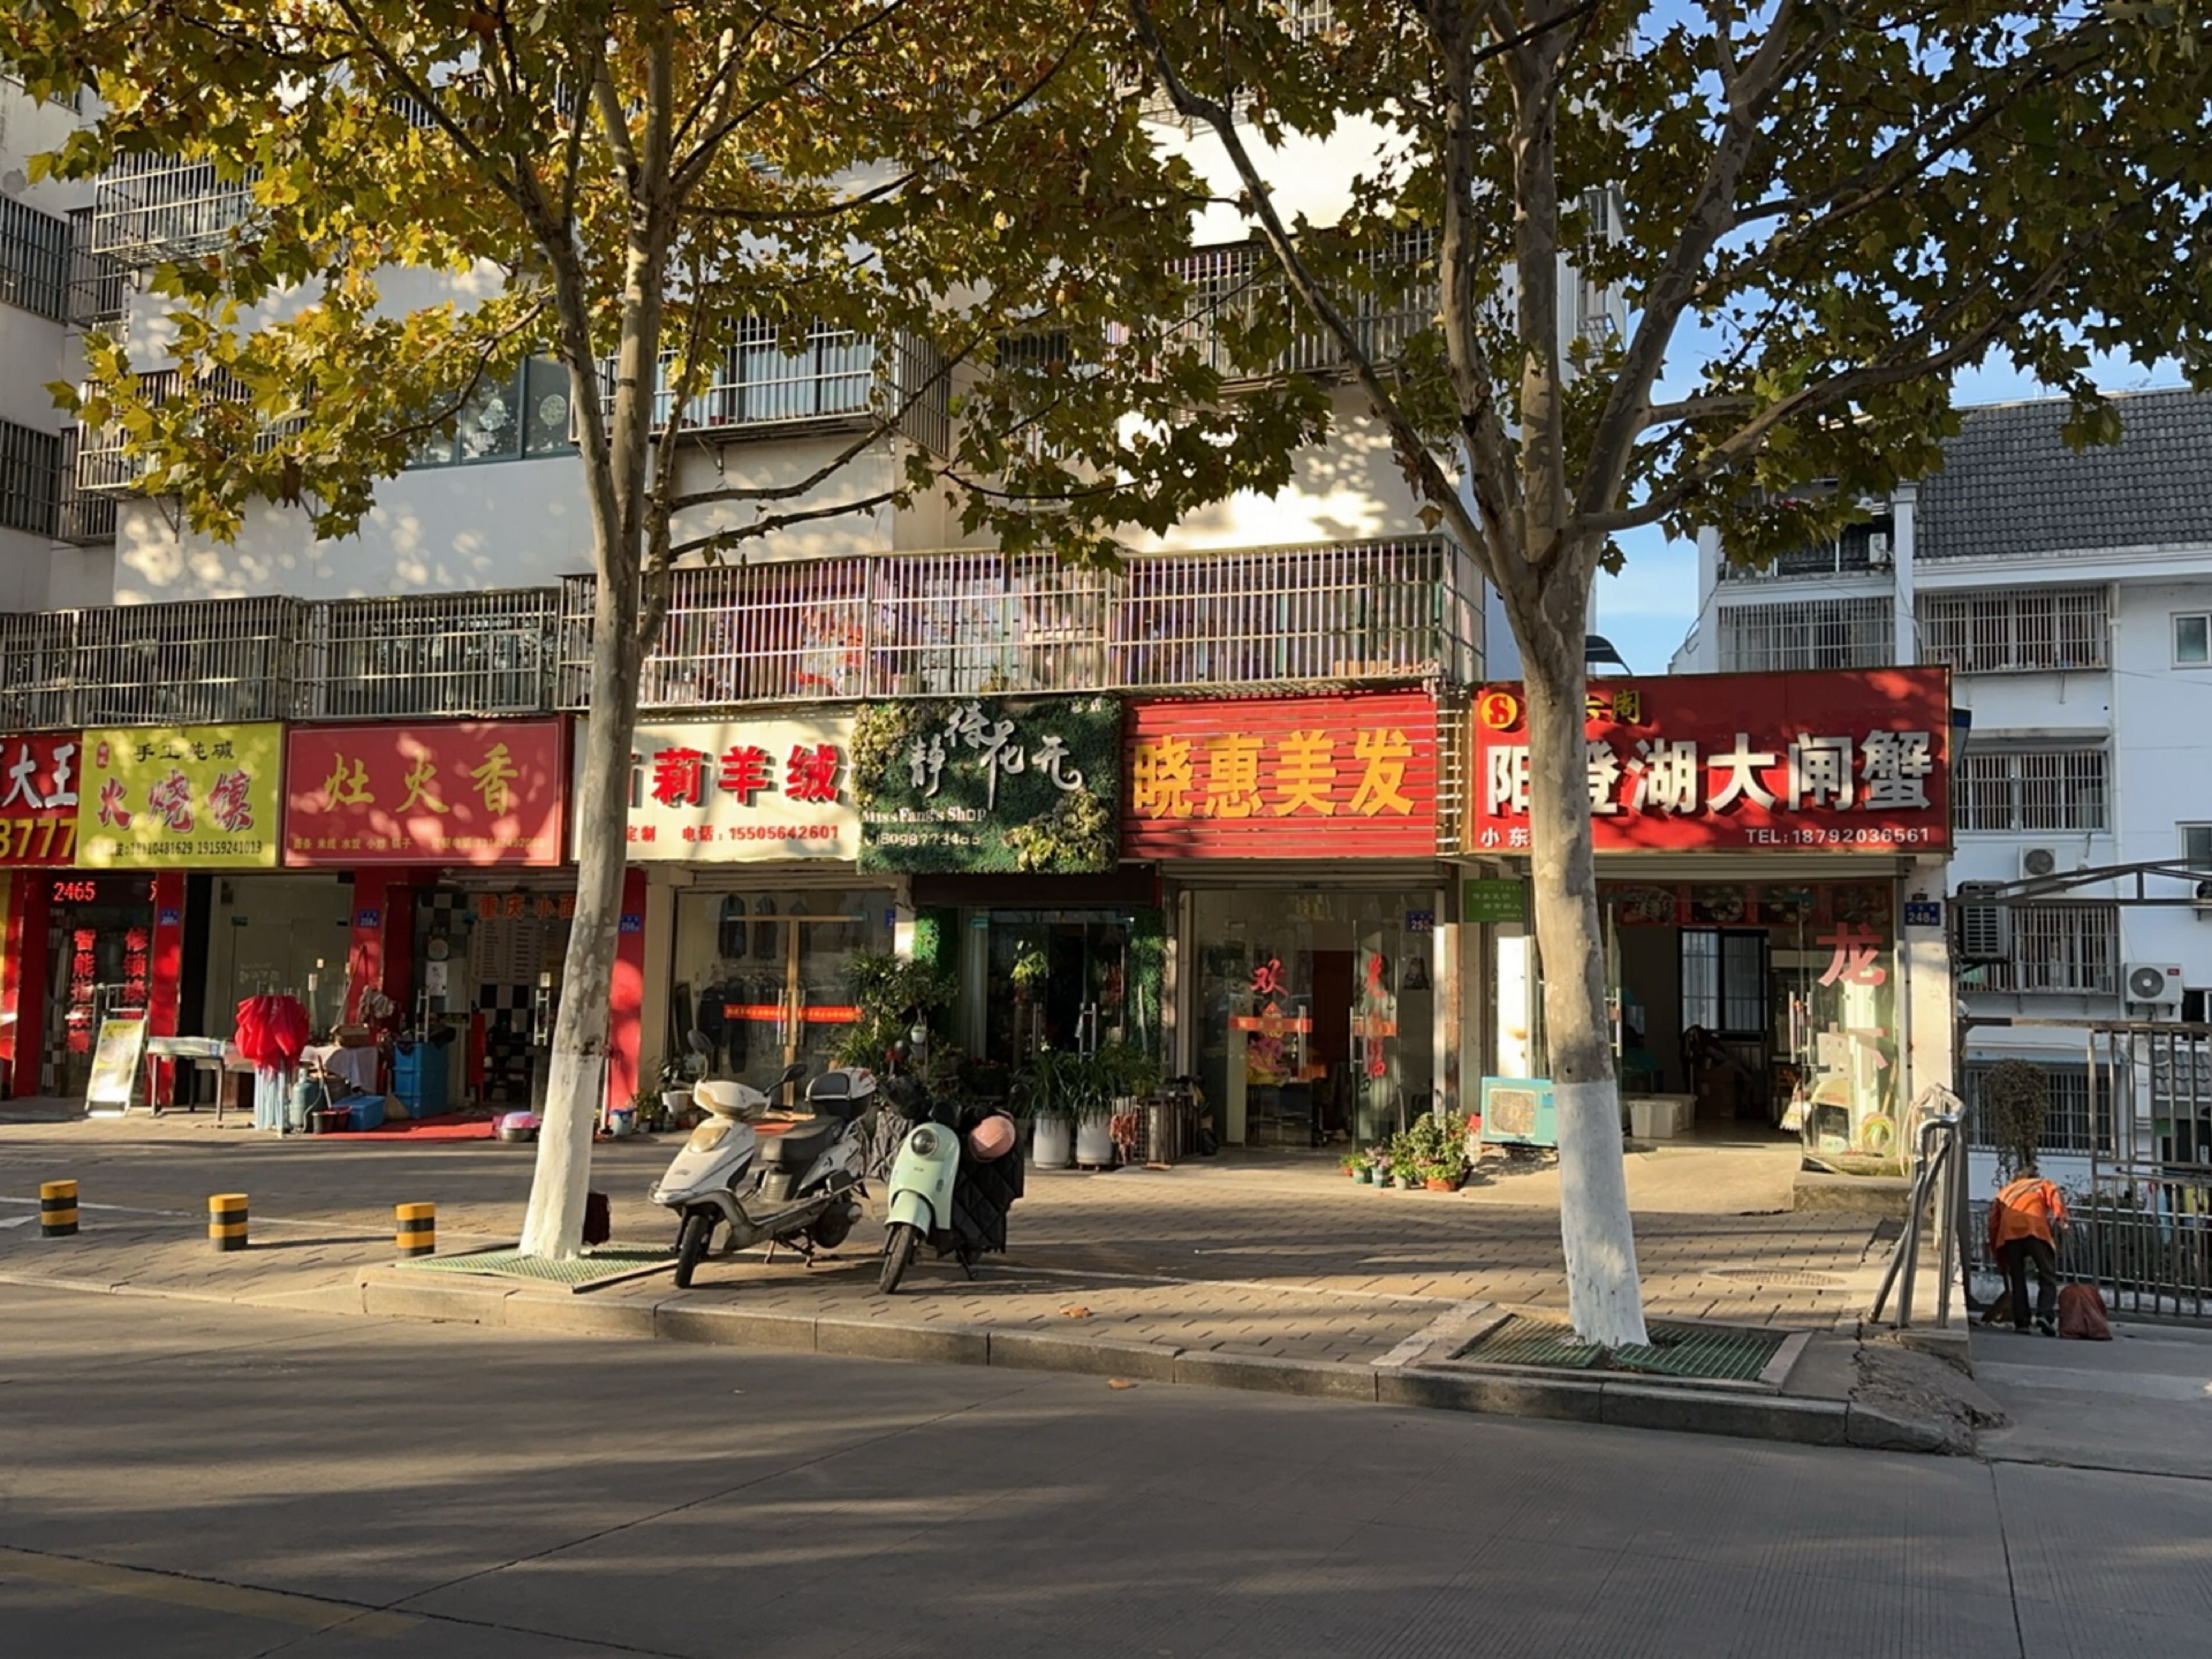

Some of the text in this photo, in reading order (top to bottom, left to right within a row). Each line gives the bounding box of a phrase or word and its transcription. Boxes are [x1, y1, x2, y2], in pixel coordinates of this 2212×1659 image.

[0, 742, 78, 808] 大王
[323, 742, 519, 817] 灶火香
[630, 743, 839, 805] 莉羊绒
[909, 700, 1083, 810] 静待花开
[1132, 726, 1416, 819] 晓惠美发
[1745, 827, 1930, 845] TEL:18792036561
[53, 881, 96, 902] 2465
[477, 892, 576, 920] 重庆小面
